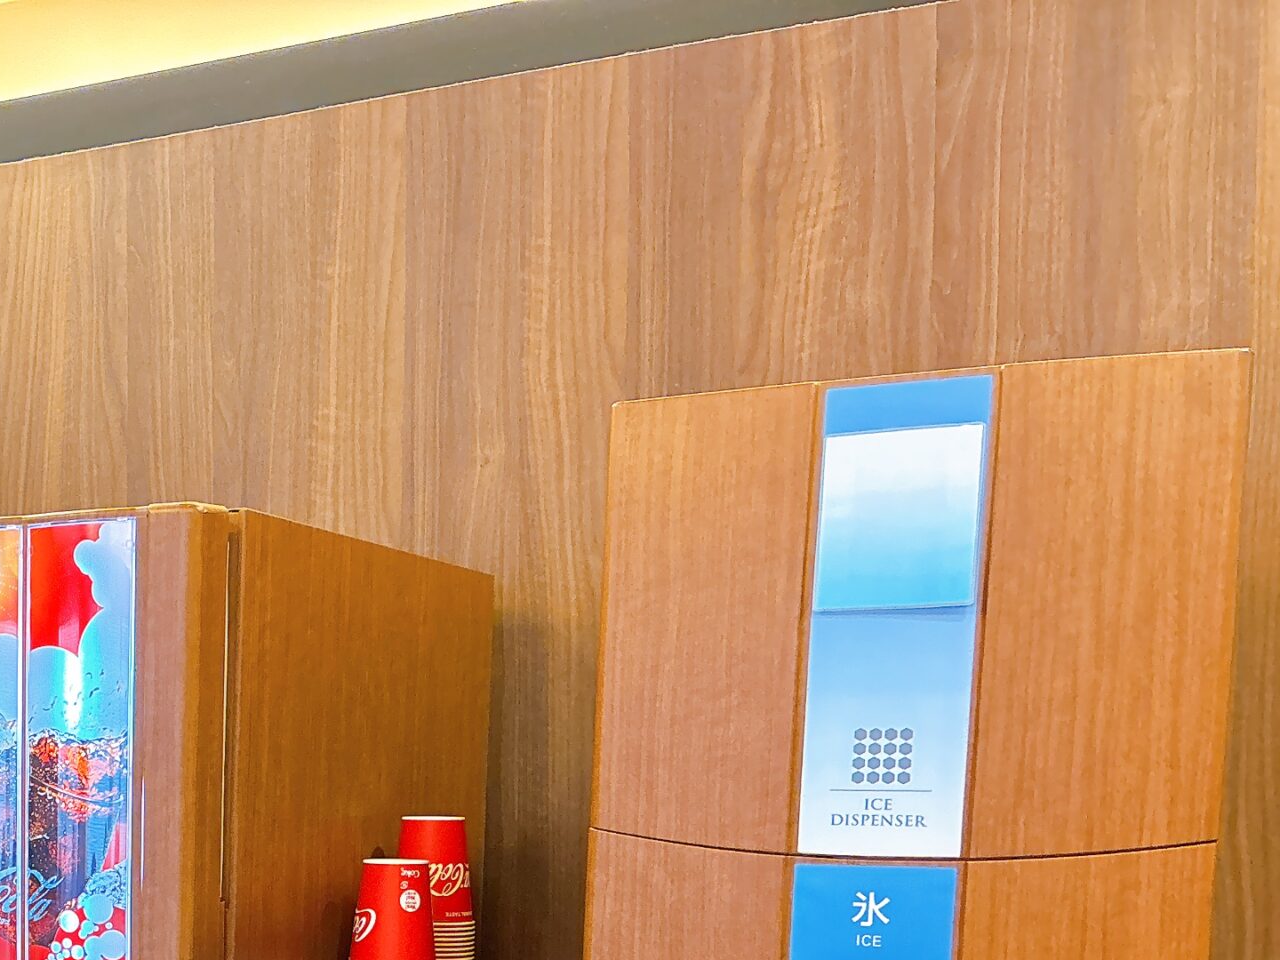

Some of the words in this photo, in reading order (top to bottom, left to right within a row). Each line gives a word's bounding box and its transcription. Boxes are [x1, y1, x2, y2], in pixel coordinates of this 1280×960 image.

[864, 798, 893, 811] ICE
[831, 813, 927, 827] DISPENSER
[851, 891, 891, 927] 氷
[856, 934, 882, 947] ICE
